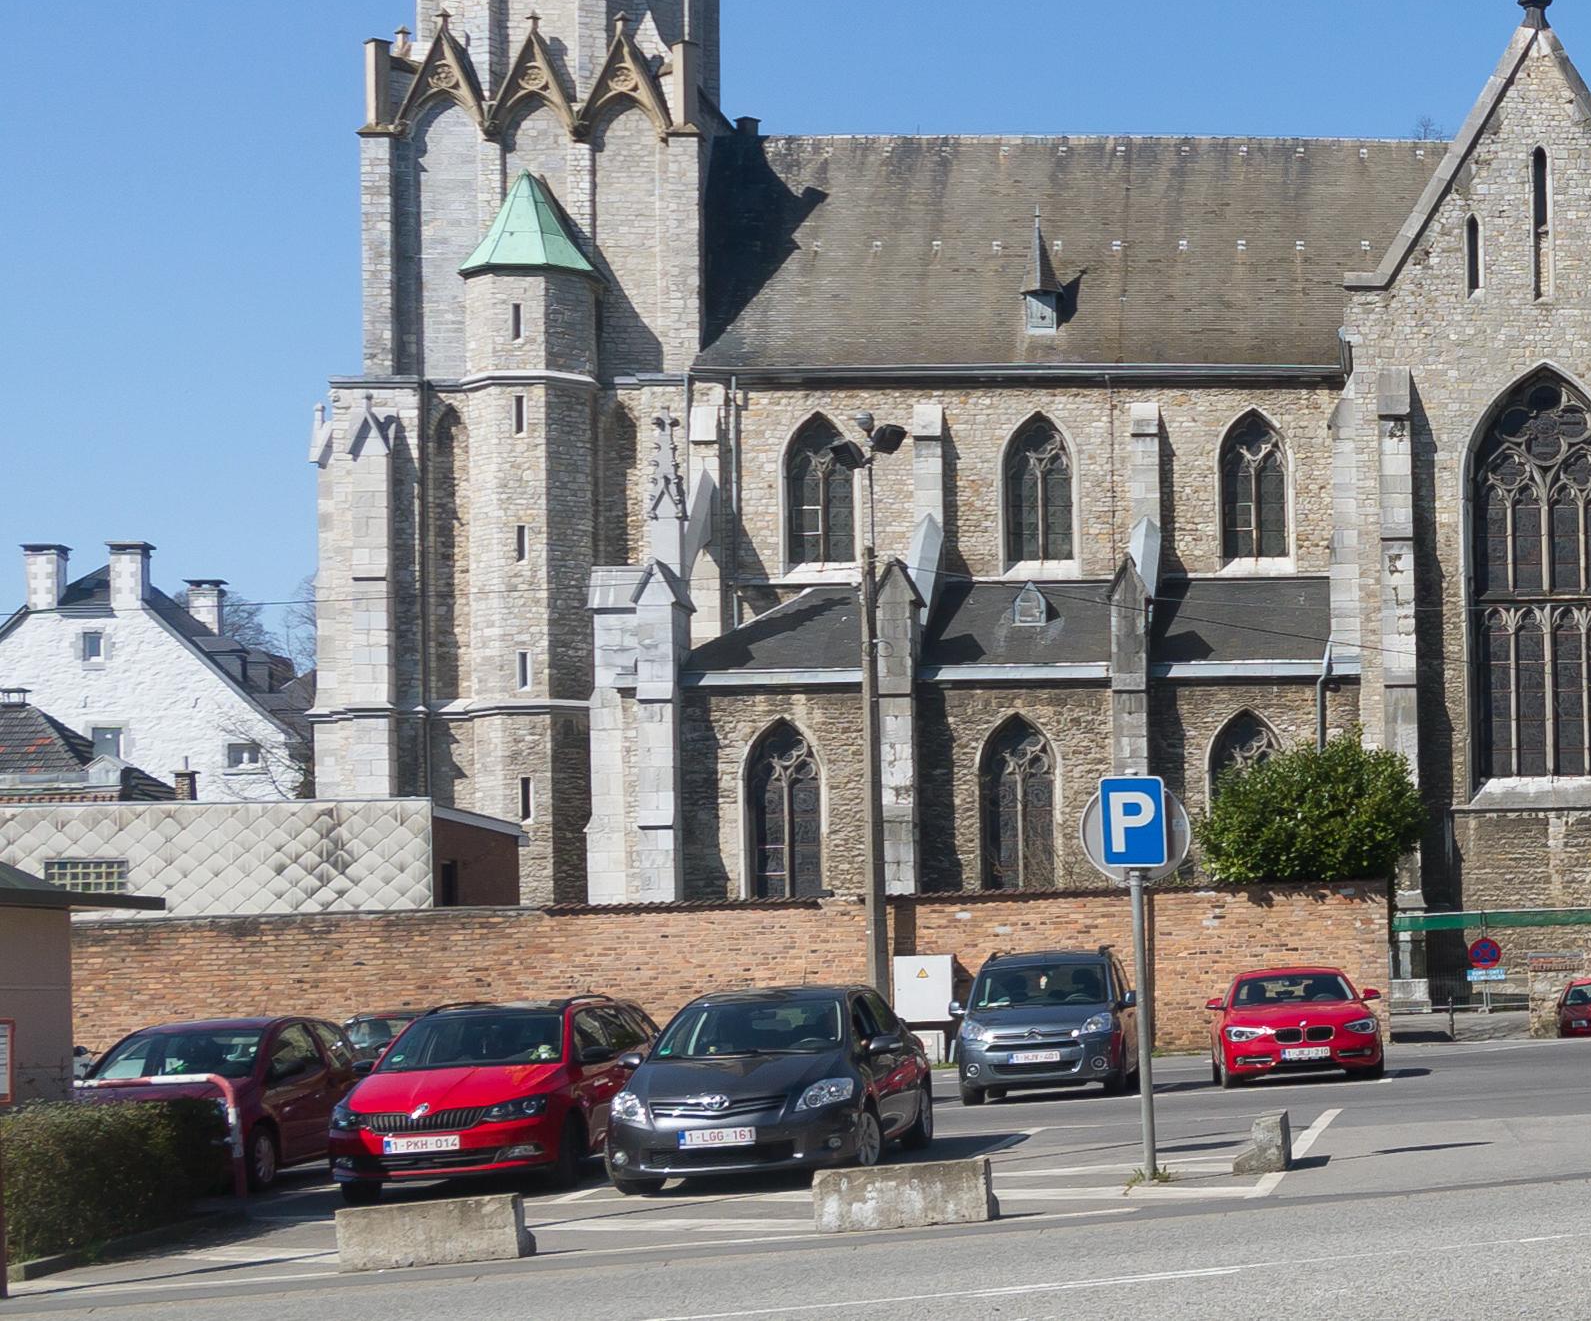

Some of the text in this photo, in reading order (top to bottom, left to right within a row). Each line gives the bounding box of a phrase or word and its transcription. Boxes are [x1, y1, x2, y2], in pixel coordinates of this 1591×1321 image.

[1109, 791, 1156, 853] P
[688, 1128, 753, 1143] 1-LGG-161
[392, 1137, 457, 1151] 1-PKH-014
